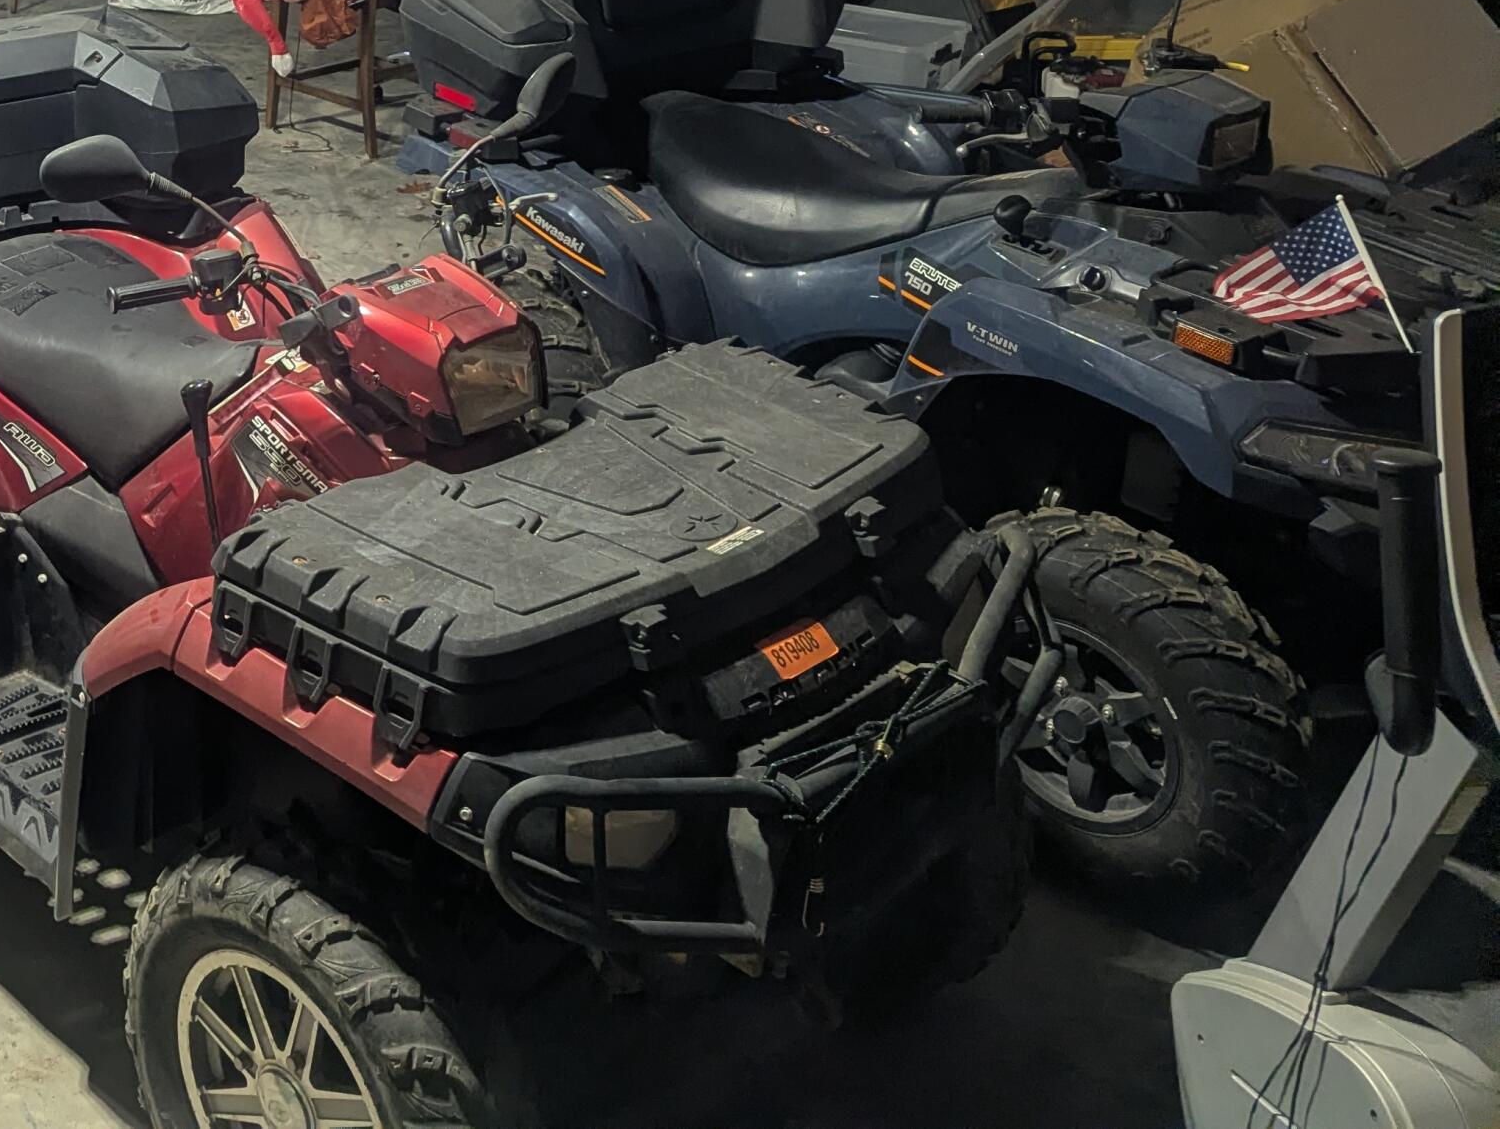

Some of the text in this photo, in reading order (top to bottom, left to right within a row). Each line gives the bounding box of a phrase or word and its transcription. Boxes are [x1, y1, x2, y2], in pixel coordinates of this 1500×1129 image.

[525, 206, 586, 254] Kawasaki
[904, 271, 933, 296] 750
[966, 321, 1019, 353] V-TWIN
[2, 421, 56, 467] AWD
[248, 429, 302, 487] 550
[251, 414, 329, 494] SPORTSMA
[770, 630, 820, 669] 819408
